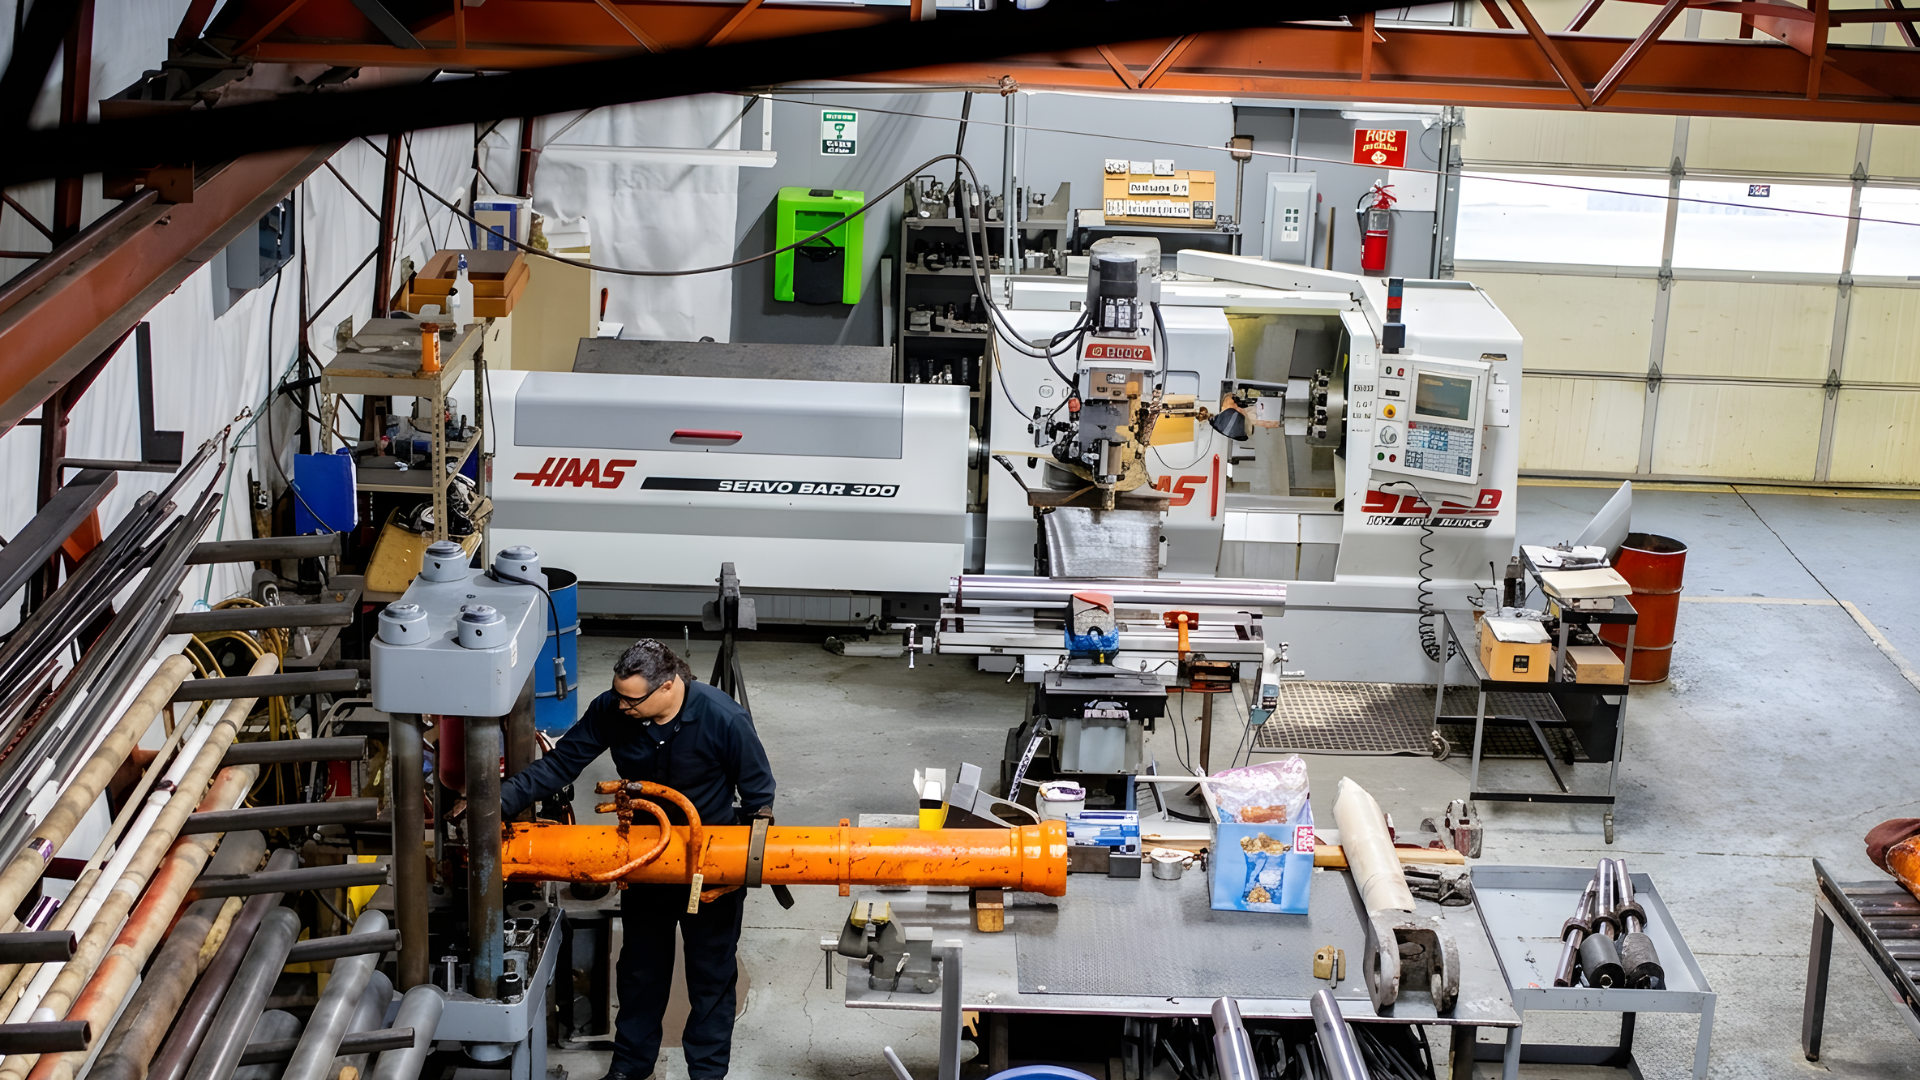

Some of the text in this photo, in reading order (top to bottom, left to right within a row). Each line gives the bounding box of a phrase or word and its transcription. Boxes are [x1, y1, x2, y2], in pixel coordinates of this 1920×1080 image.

[513, 457, 637, 489] HAAS
[718, 480, 896, 497] SERVO BAR 300
